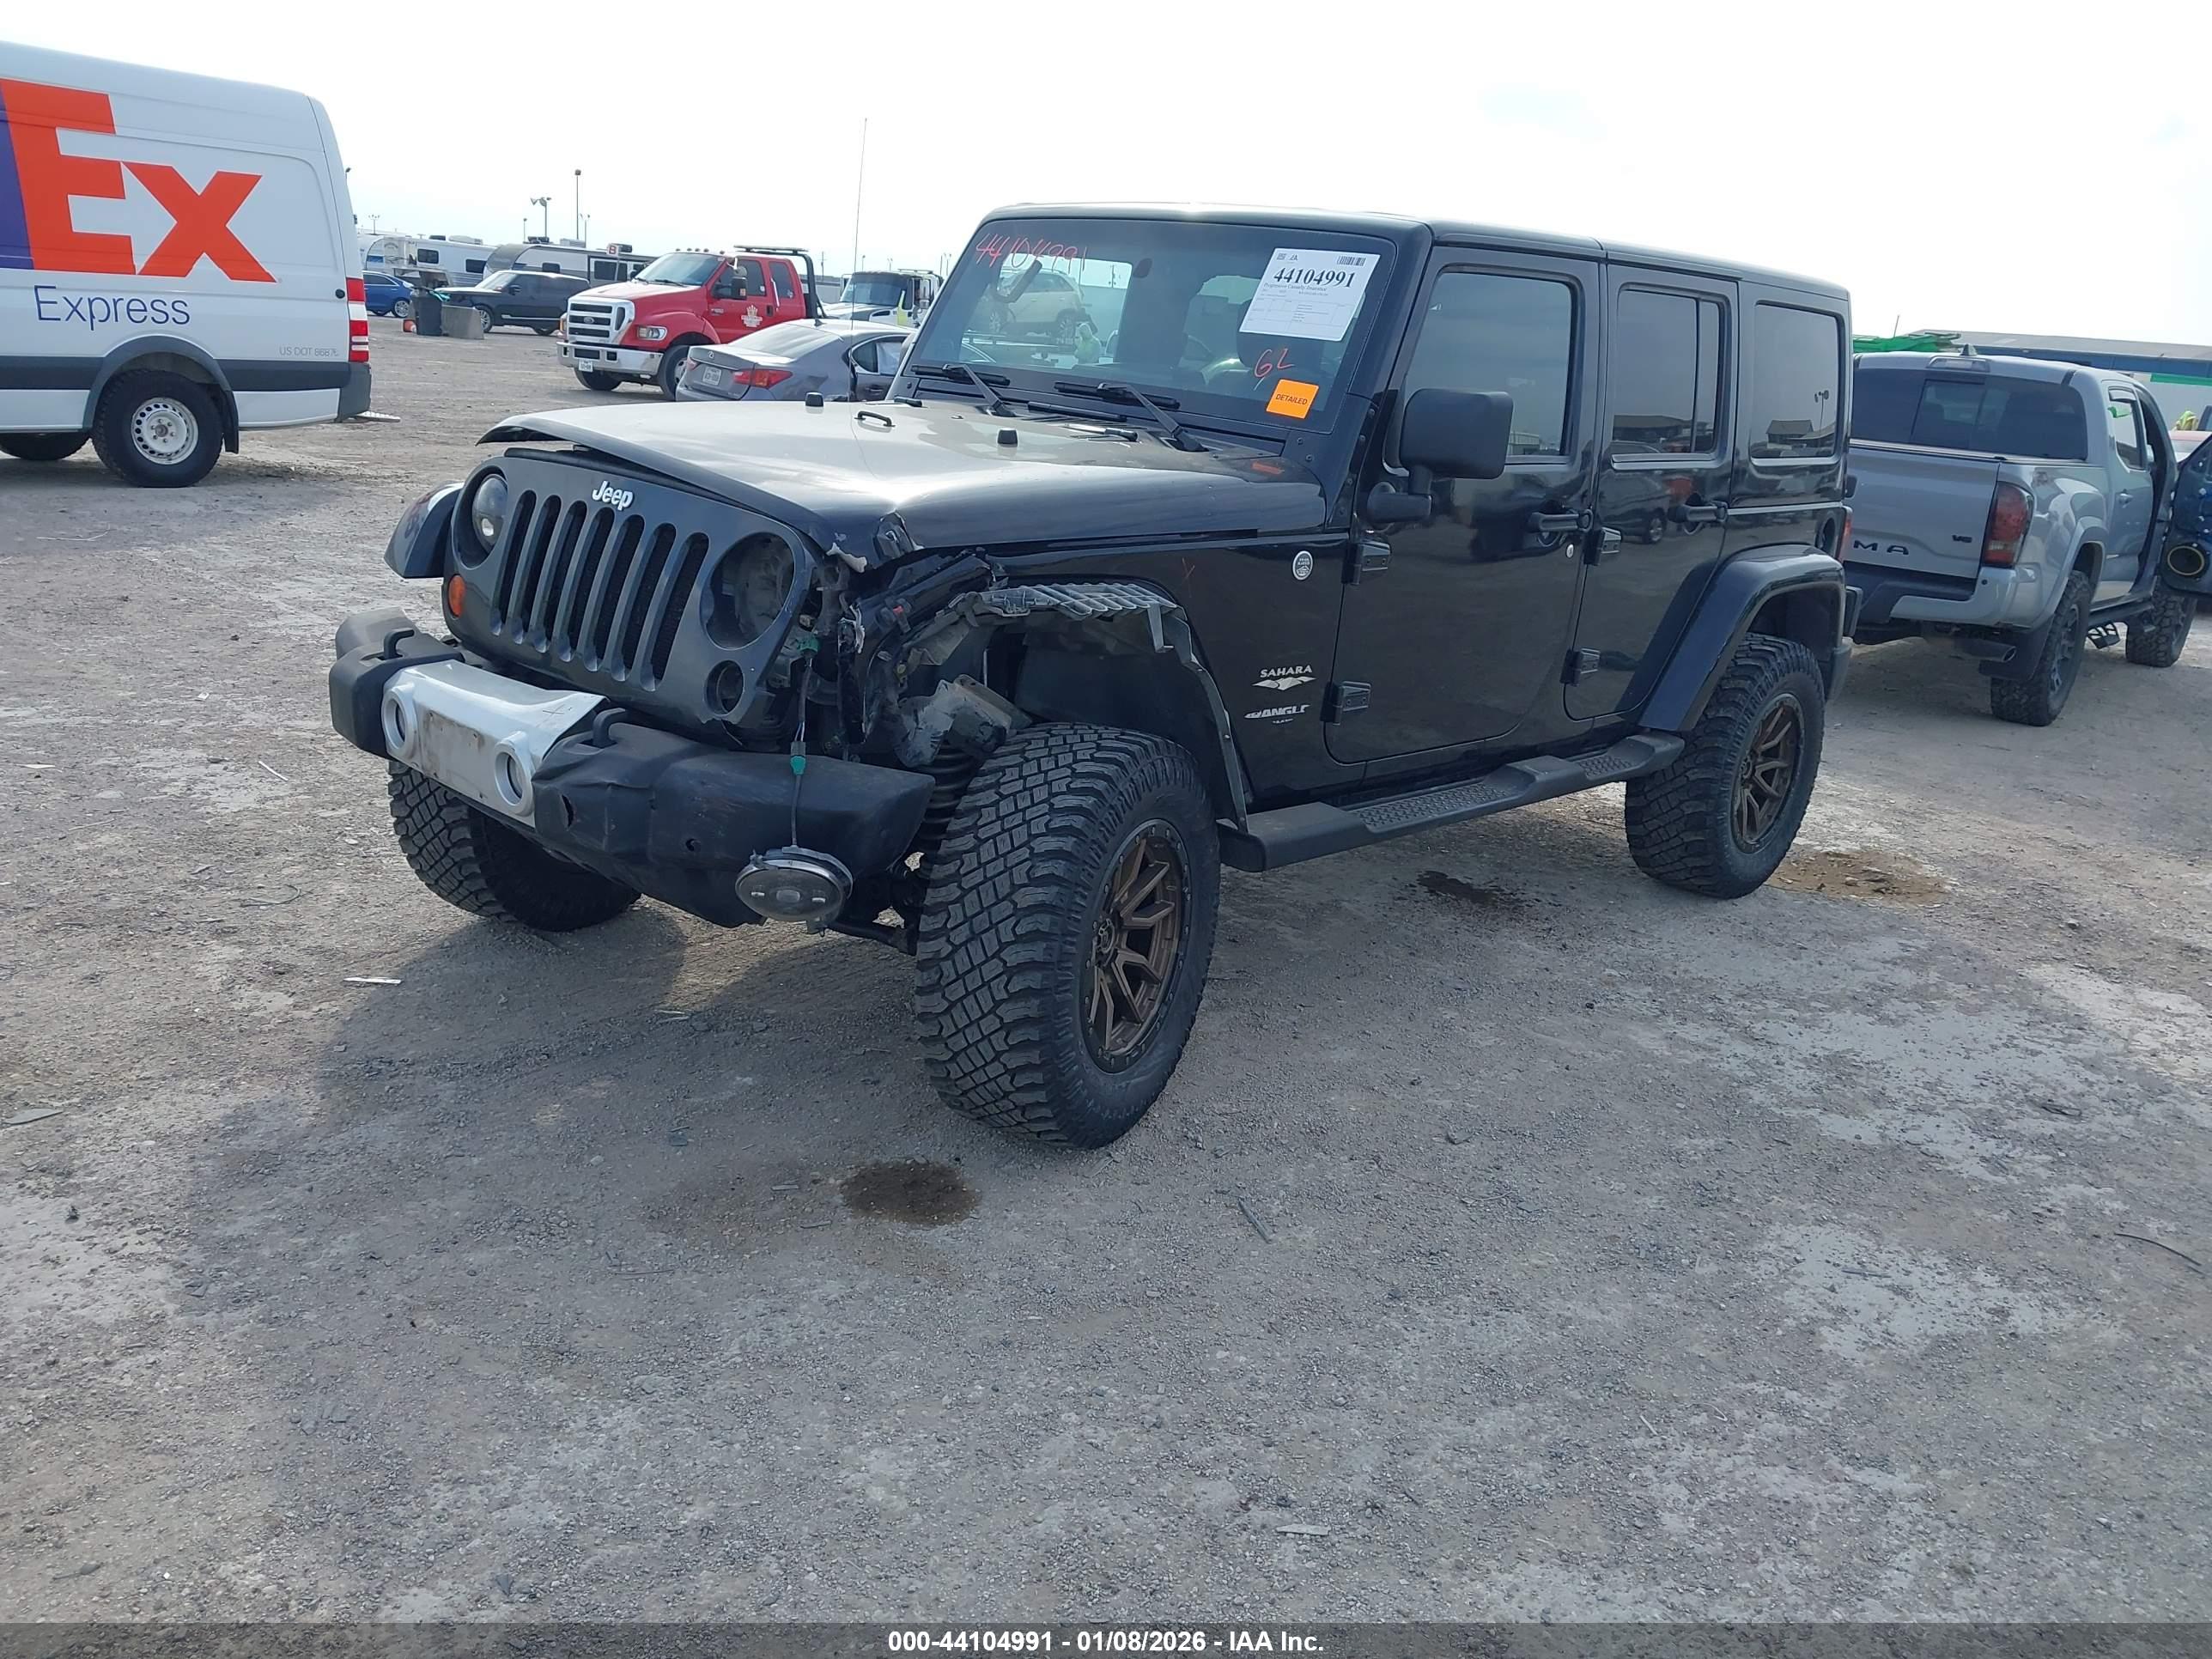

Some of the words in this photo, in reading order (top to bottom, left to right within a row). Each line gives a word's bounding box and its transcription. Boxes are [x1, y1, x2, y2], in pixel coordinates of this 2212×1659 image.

[0, 77, 278, 283] Ex
[975, 234, 1087, 274] 44104991
[1273, 267, 1356, 288] 44104991
[34, 284, 191, 331] Express
[279, 346, 292, 356] US
[294, 347, 313, 356] DOT
[1275, 393, 1308, 405] DETAILED
[592, 480, 634, 511] Jeep
[1952, 534, 1972, 544] V6
[1260, 664, 1313, 678] SAHARA
